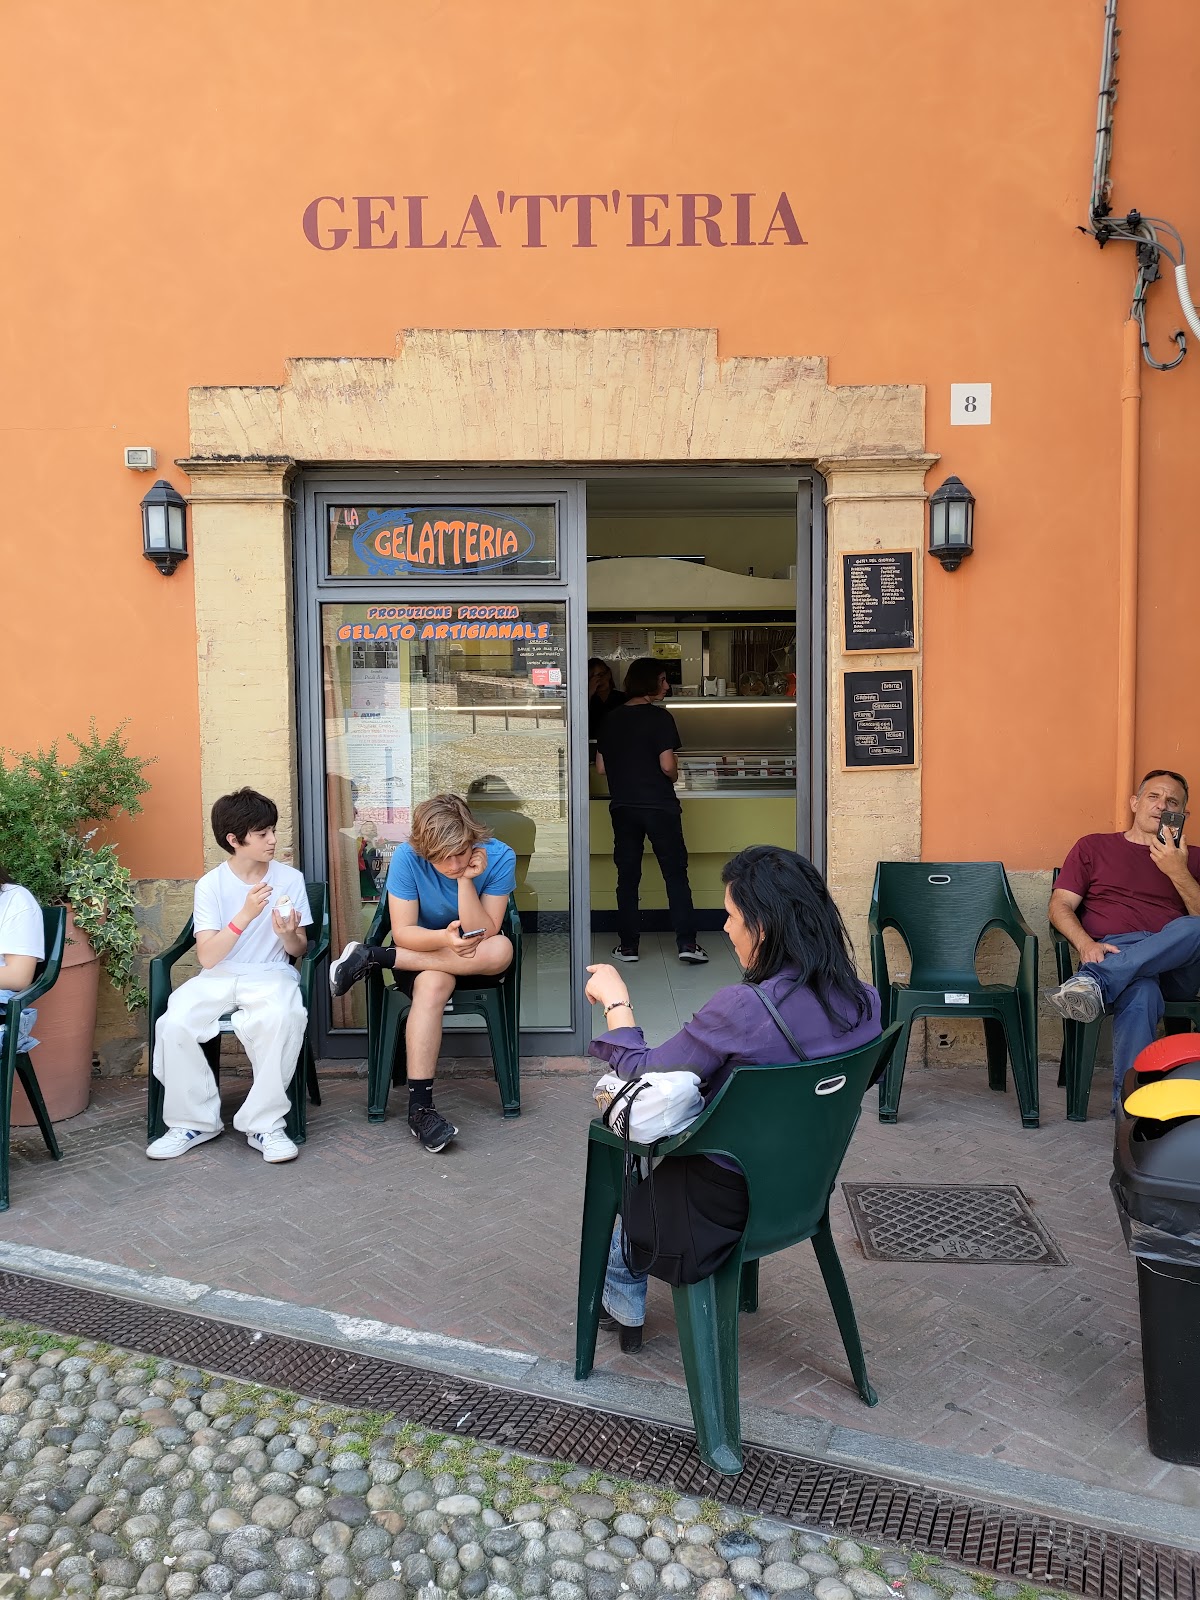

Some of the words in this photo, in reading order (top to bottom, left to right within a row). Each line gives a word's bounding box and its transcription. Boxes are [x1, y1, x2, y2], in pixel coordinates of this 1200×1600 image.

[302, 189, 808, 250] GELA'TT'ERIA
[964, 395, 977, 412] 8
[344, 507, 359, 525] LA
[374, 520, 518, 565] GELATTERIA
[367, 606, 452, 621] PRODUZIONE
[457, 606, 519, 620] PROPRIA
[337, 622, 417, 641] GELATO
[419, 622, 550, 641] ARTIGIANALE
[935, 1244, 983, 1253] ENEL
